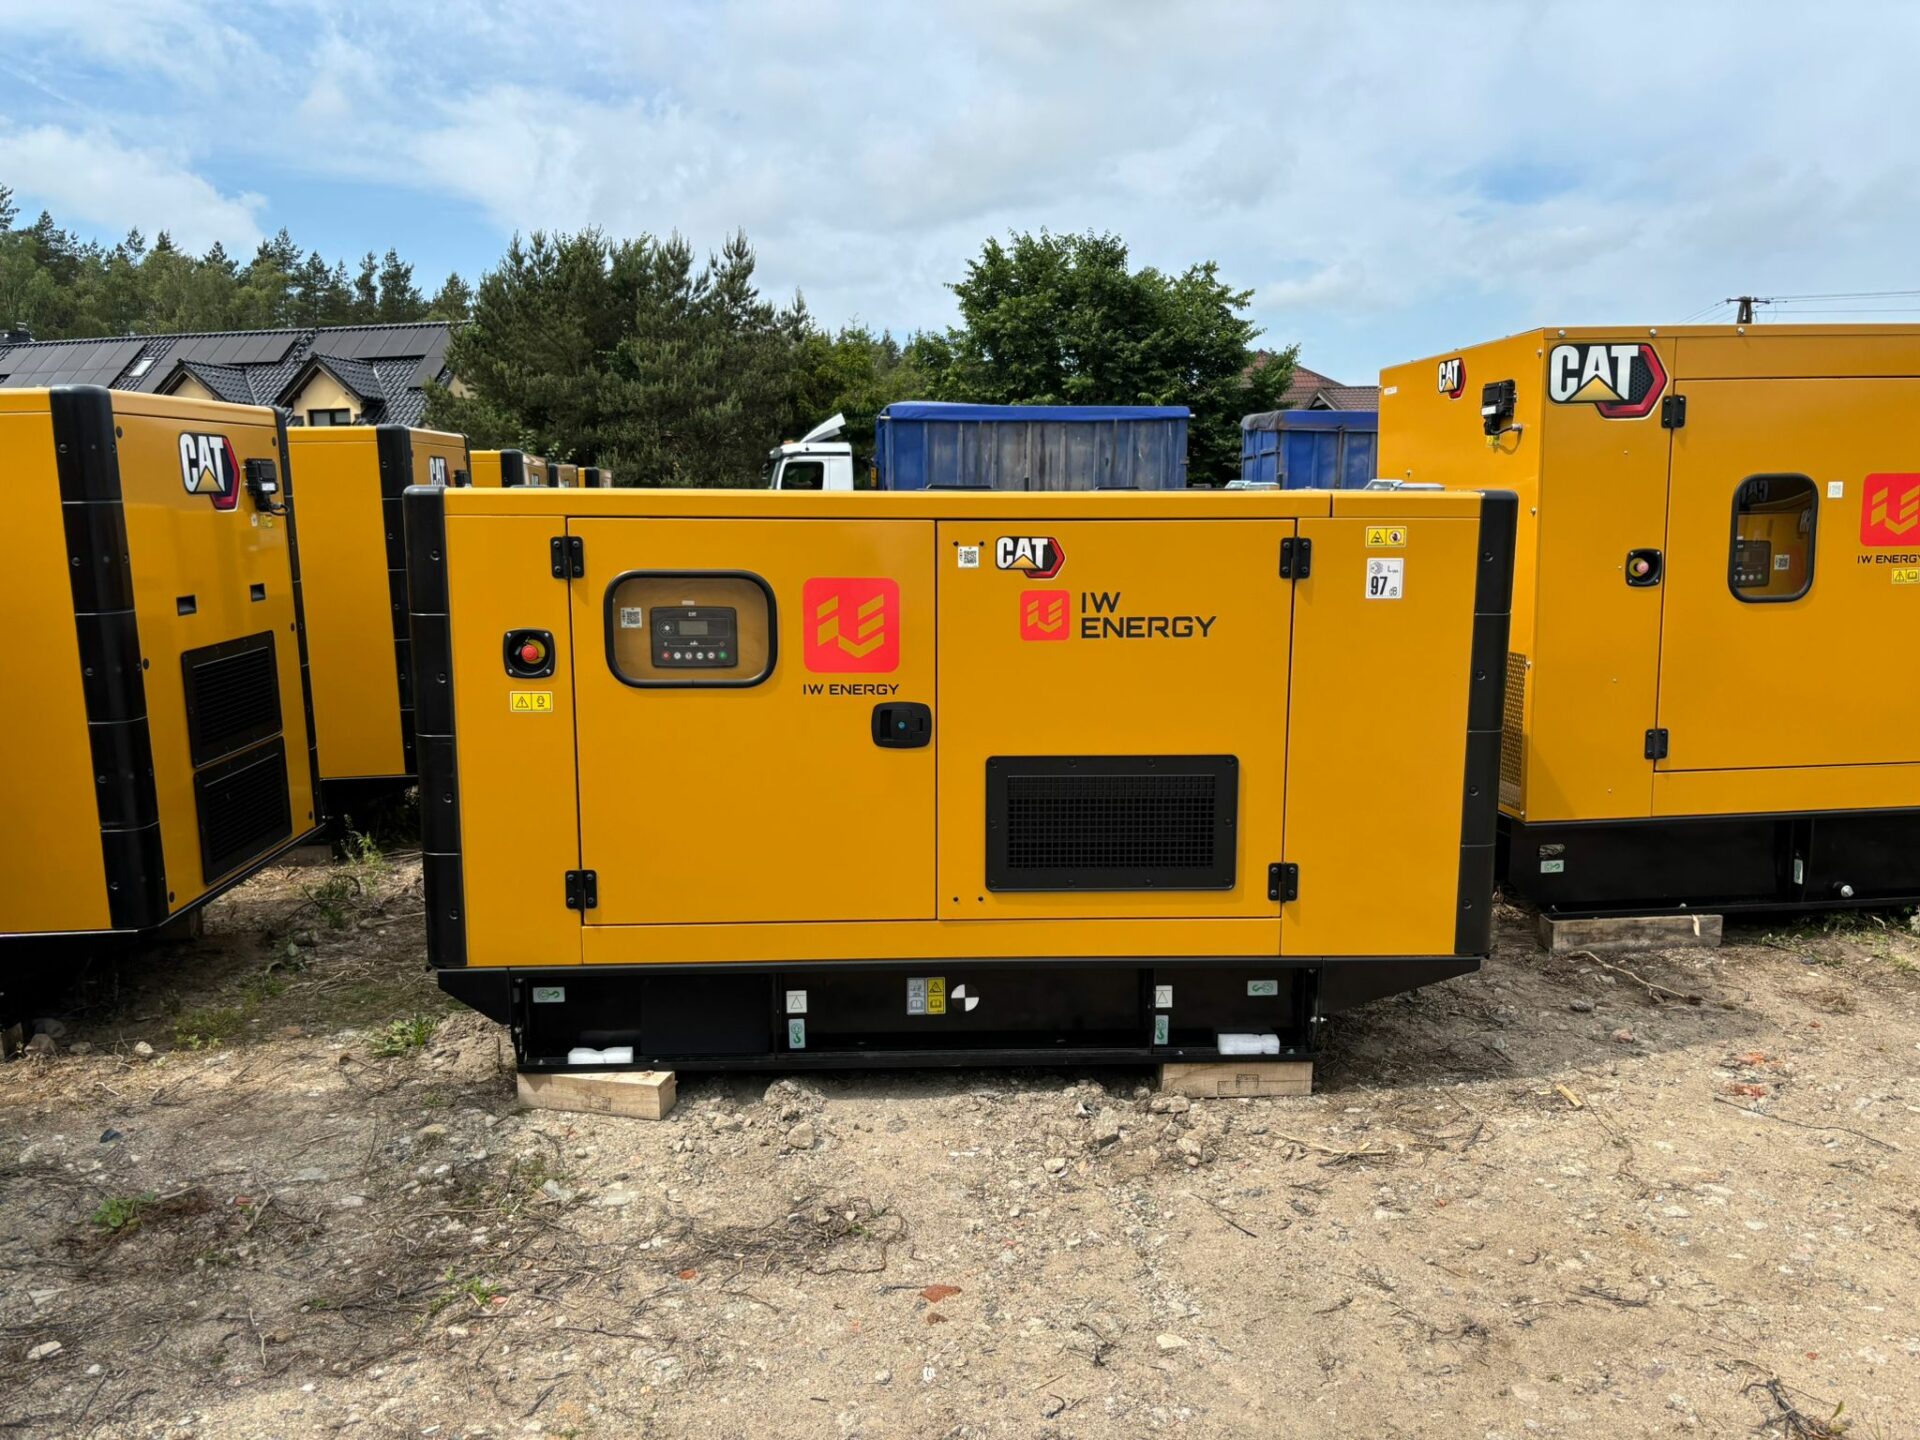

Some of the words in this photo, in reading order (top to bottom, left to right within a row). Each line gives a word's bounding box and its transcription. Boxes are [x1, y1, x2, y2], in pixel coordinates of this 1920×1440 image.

[1438, 359, 1460, 392] CAT
[1550, 345, 1639, 402] CAT
[180, 433, 226, 492] CAT
[996, 537, 1048, 569] CAT
[1857, 554, 1872, 565] IW
[1875, 554, 1920, 564] ENERG
[1370, 575, 1388, 596] 97
[1081, 592, 1121, 613] IW
[1081, 615, 1217, 639] ENERGY
[803, 683, 824, 695] IW
[829, 683, 899, 695] ENERGY
